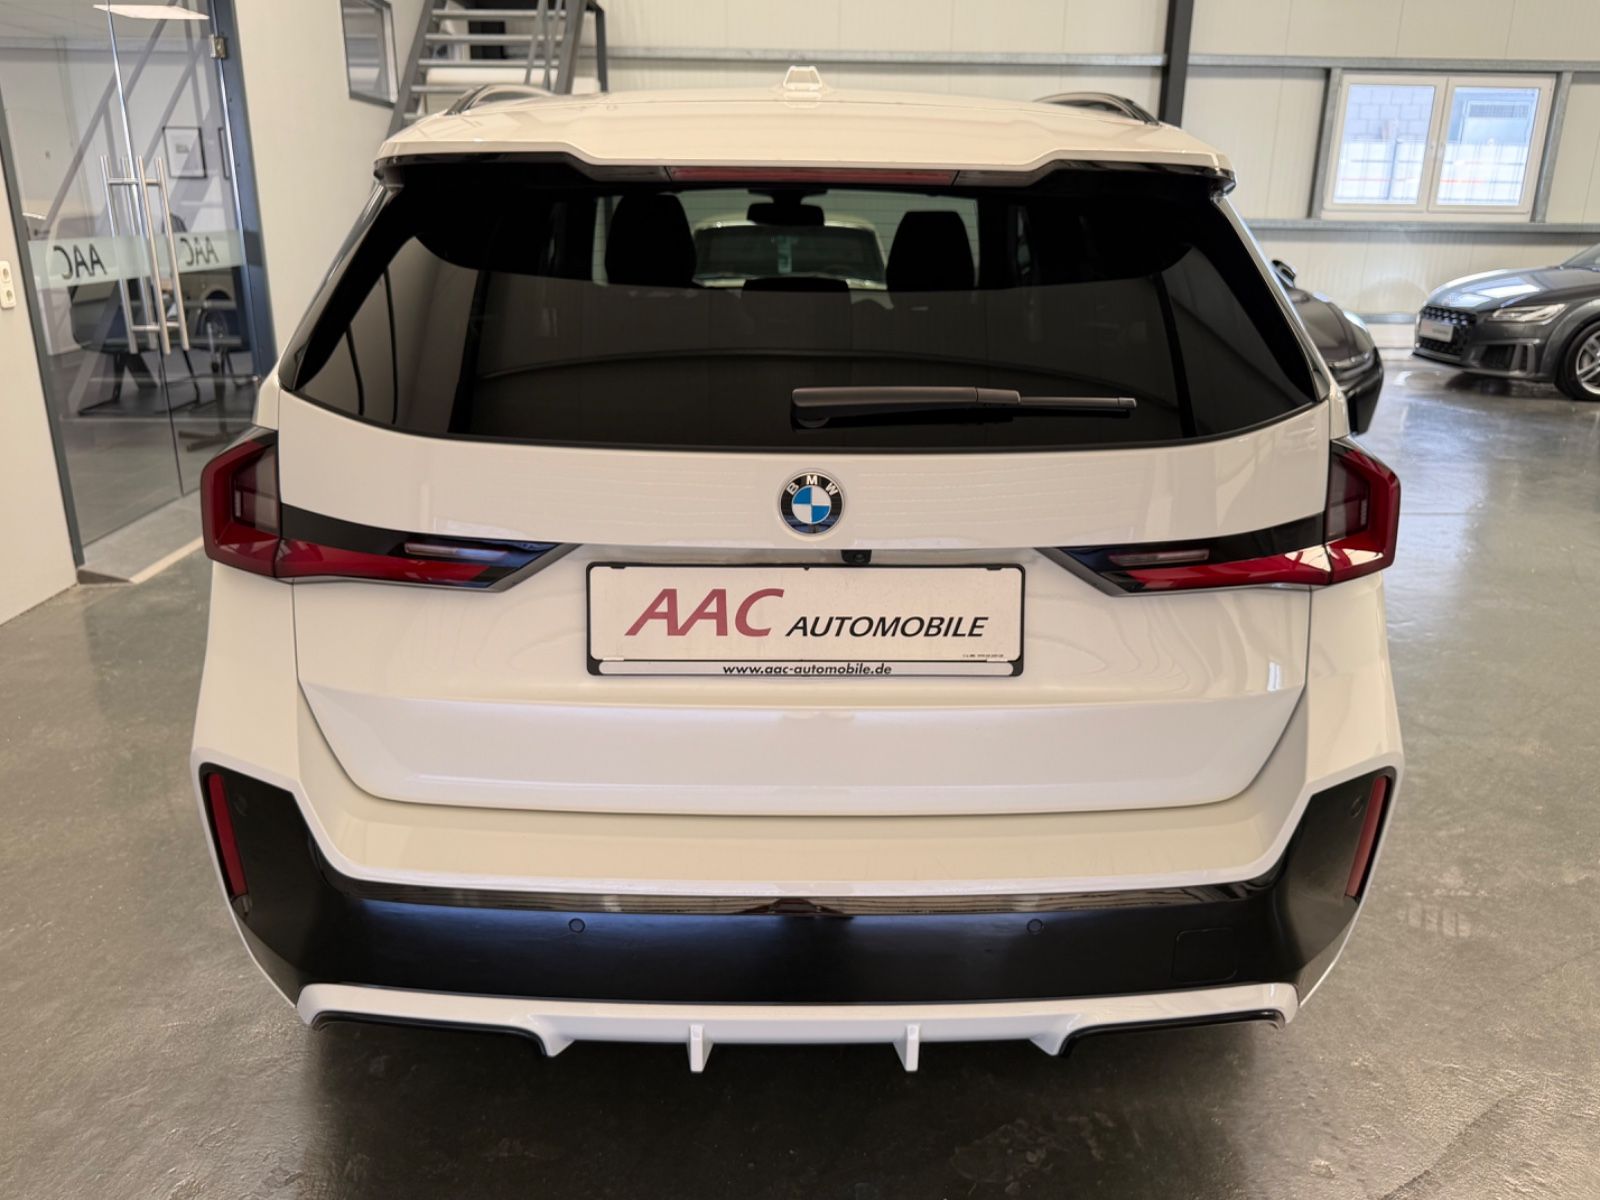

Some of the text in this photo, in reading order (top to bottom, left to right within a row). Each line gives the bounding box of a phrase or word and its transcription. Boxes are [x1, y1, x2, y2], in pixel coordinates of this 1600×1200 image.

[786, 475, 839, 496] BMW
[625, 588, 989, 638] AAC AUTOMOBILE
[723, 662, 892, 675] www.aac-automobile.de
